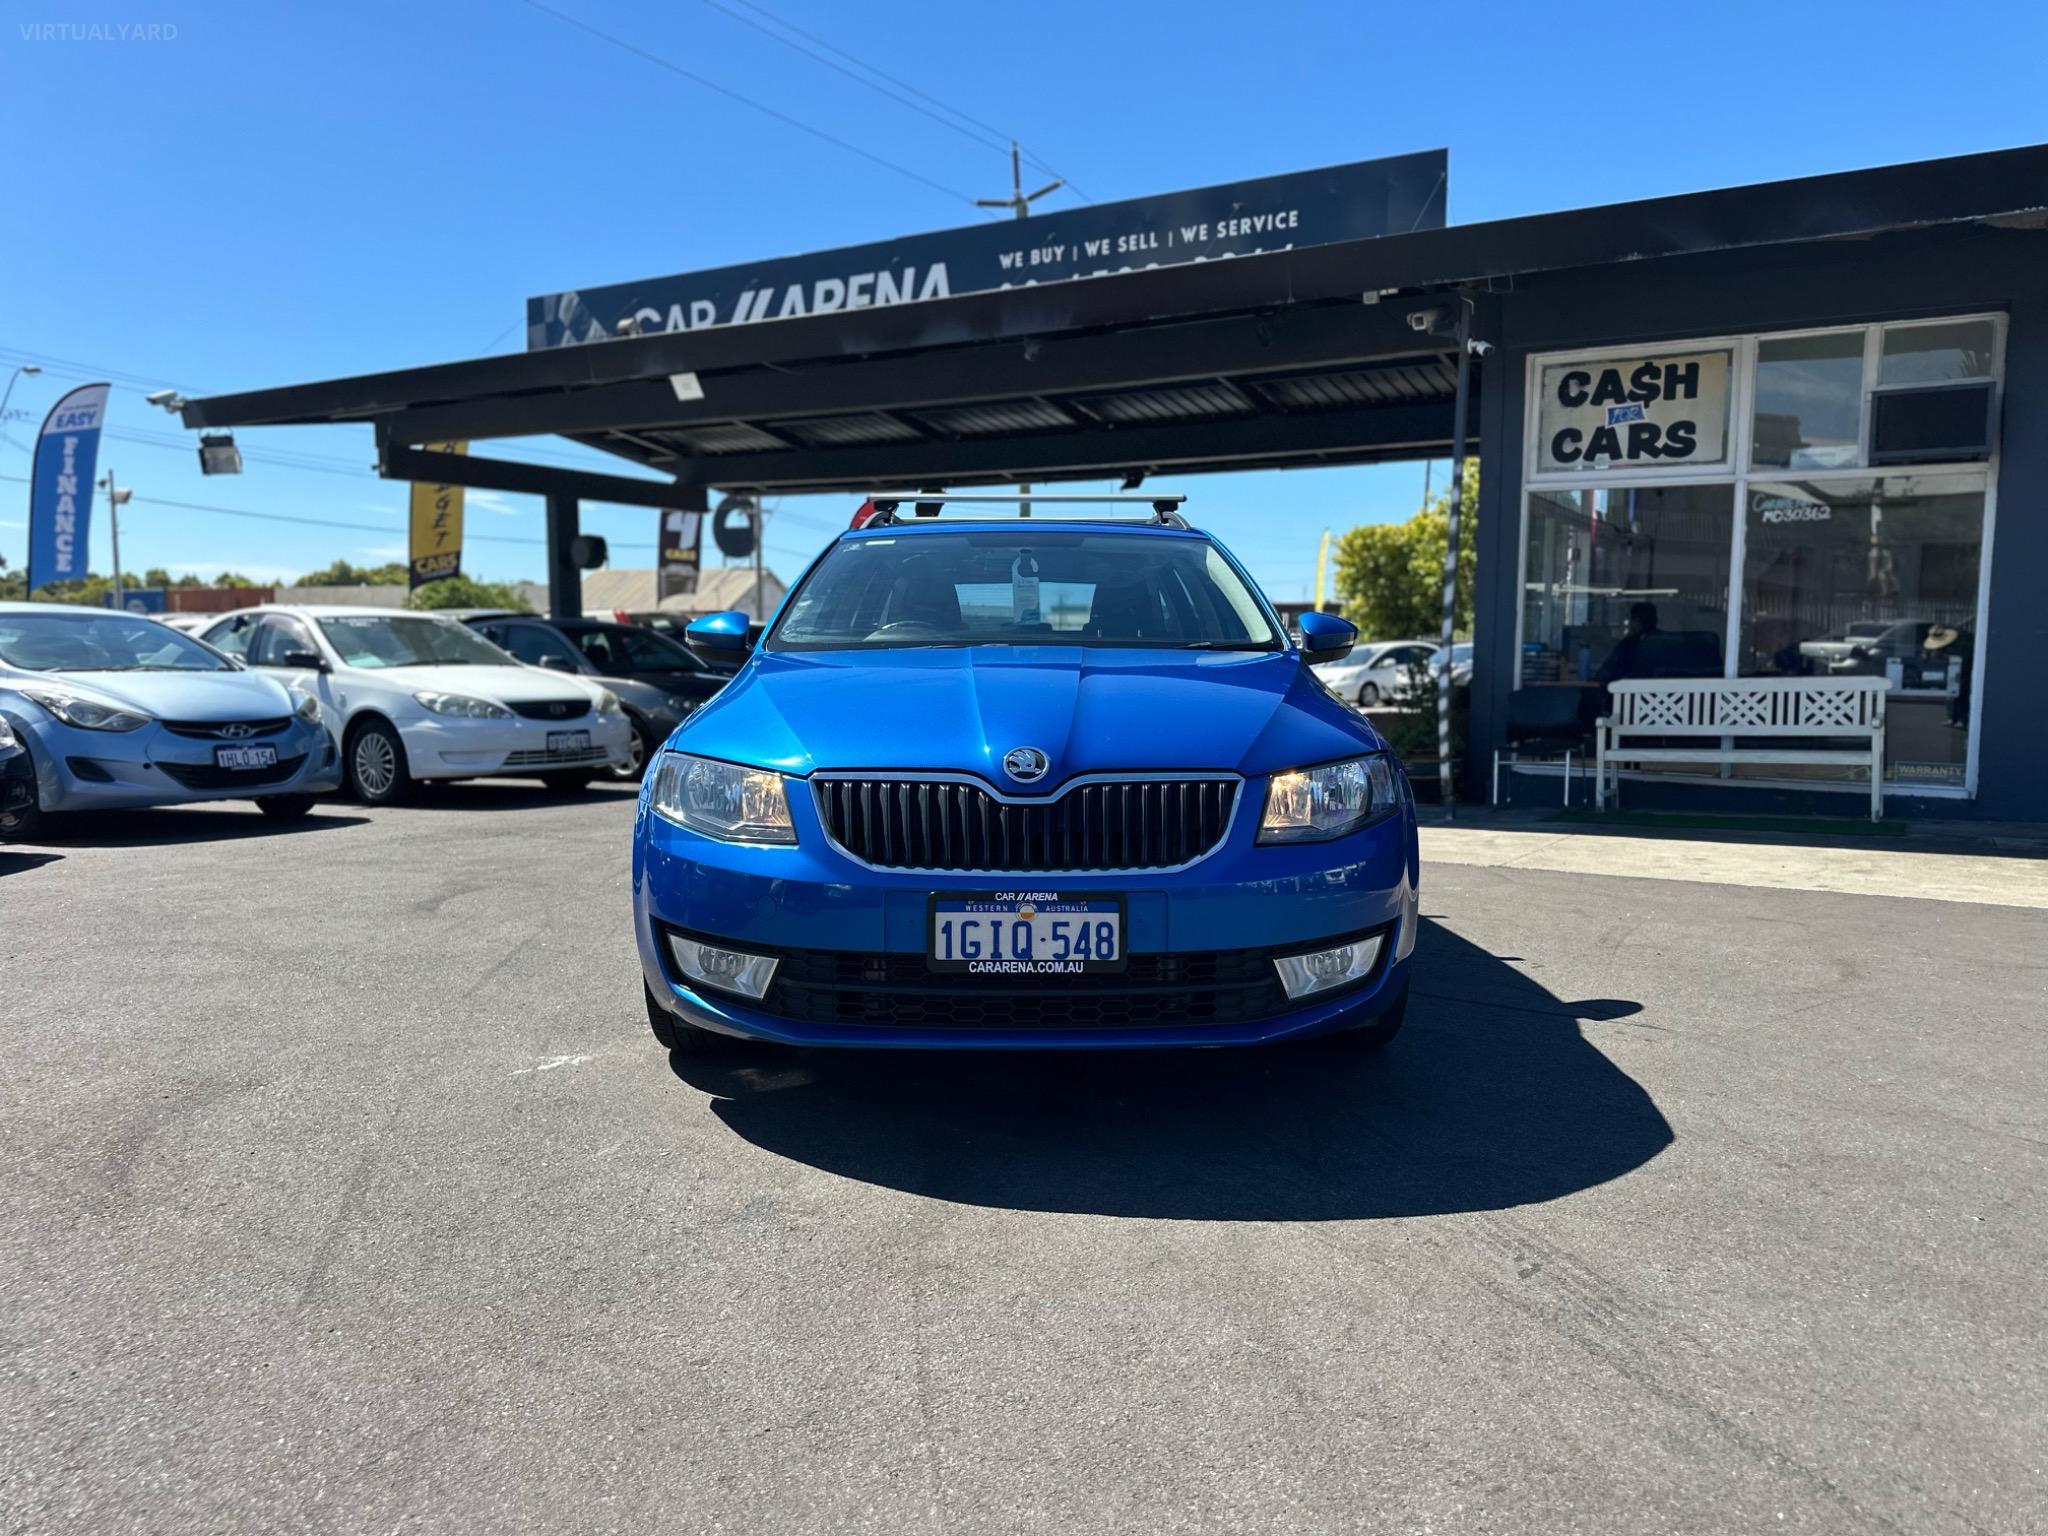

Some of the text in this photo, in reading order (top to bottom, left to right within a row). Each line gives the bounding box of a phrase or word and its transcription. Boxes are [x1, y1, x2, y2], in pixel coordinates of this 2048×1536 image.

[999, 252, 1023, 270] WE
[1031, 246, 1065, 265] BUY
[1085, 239, 1110, 257] WE
[1118, 232, 1158, 253] SELL
[1181, 224, 1208, 243] WE
[1217, 210, 1299, 238] SERVICE
[56, 410, 97, 429] EASY
[1551, 420, 1697, 463] CARS
[55, 436, 79, 573] FINANCE
[1899, 765, 1962, 776] WARRANTY
[995, 892, 1015, 901] CAR
[965, 904, 1088, 912] WESTERN AUSTRALIA
[968, 961, 1084, 973] CARARENA.COM.AU
